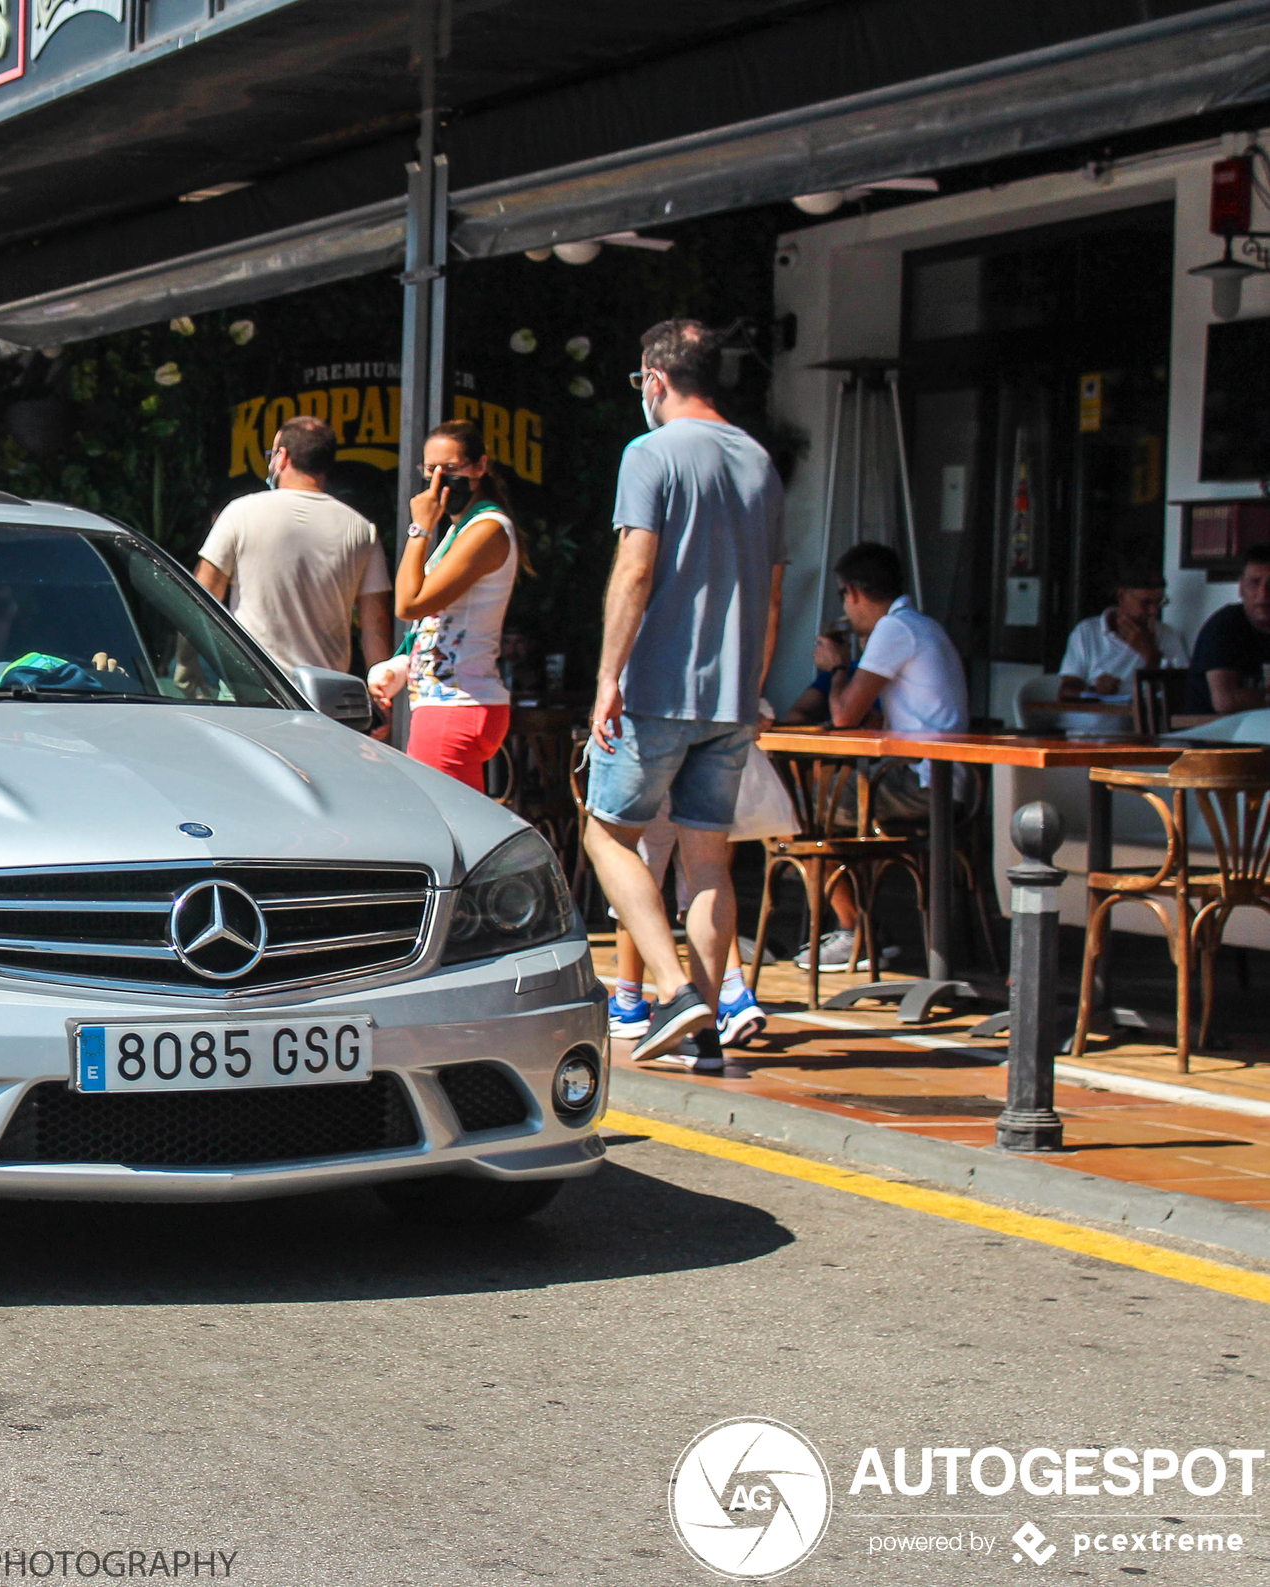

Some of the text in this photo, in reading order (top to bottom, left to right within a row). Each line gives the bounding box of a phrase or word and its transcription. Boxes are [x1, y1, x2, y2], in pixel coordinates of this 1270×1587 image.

[228, 386, 542, 484] KOPPARG
[117, 1024, 360, 1081] 8085 GSG
